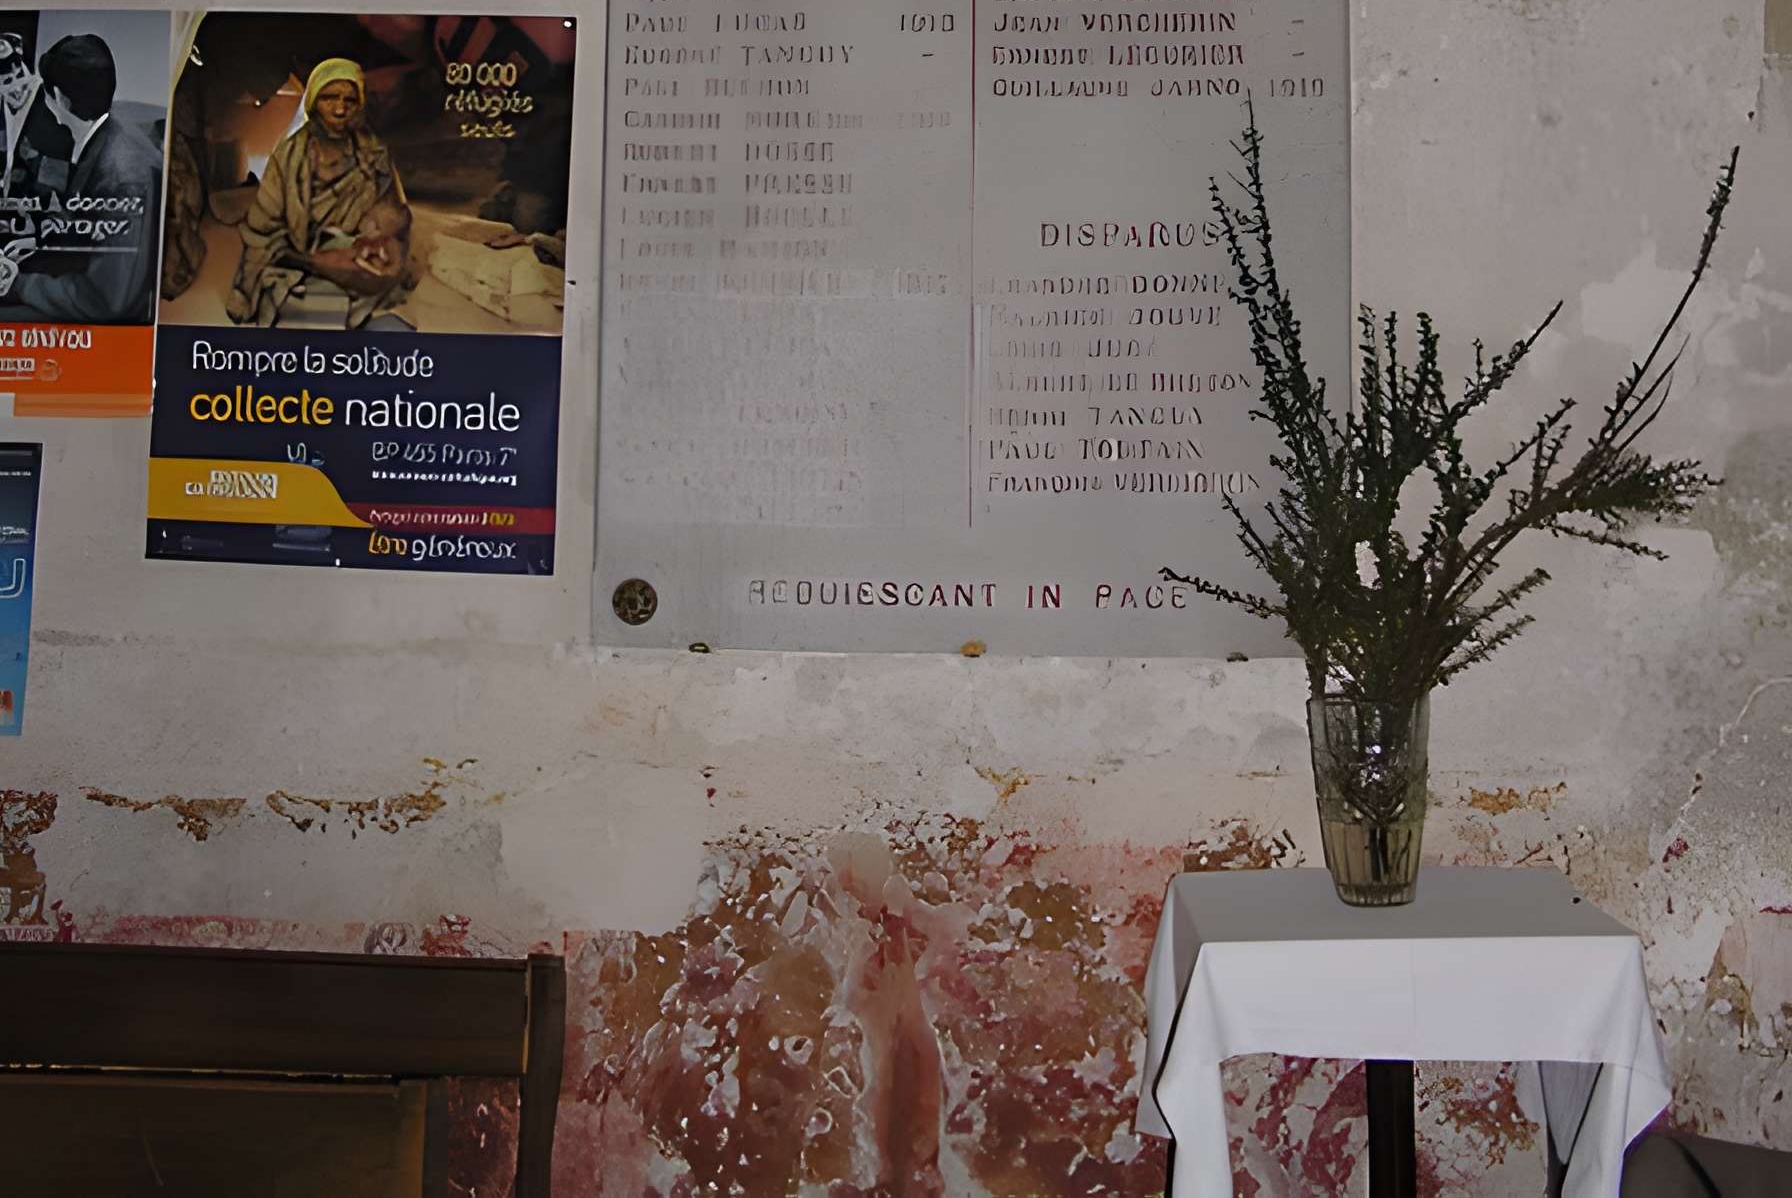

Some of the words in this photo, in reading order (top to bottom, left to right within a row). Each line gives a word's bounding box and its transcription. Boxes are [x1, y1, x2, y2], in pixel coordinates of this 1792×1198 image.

[192, 340, 297, 377] Rompre
[304, 345, 325, 373] la
[189, 386, 334, 425] collecte
[345, 390, 520, 432] nationale
[1025, 584, 1060, 609] IN
[1094, 584, 1186, 610] PACE
